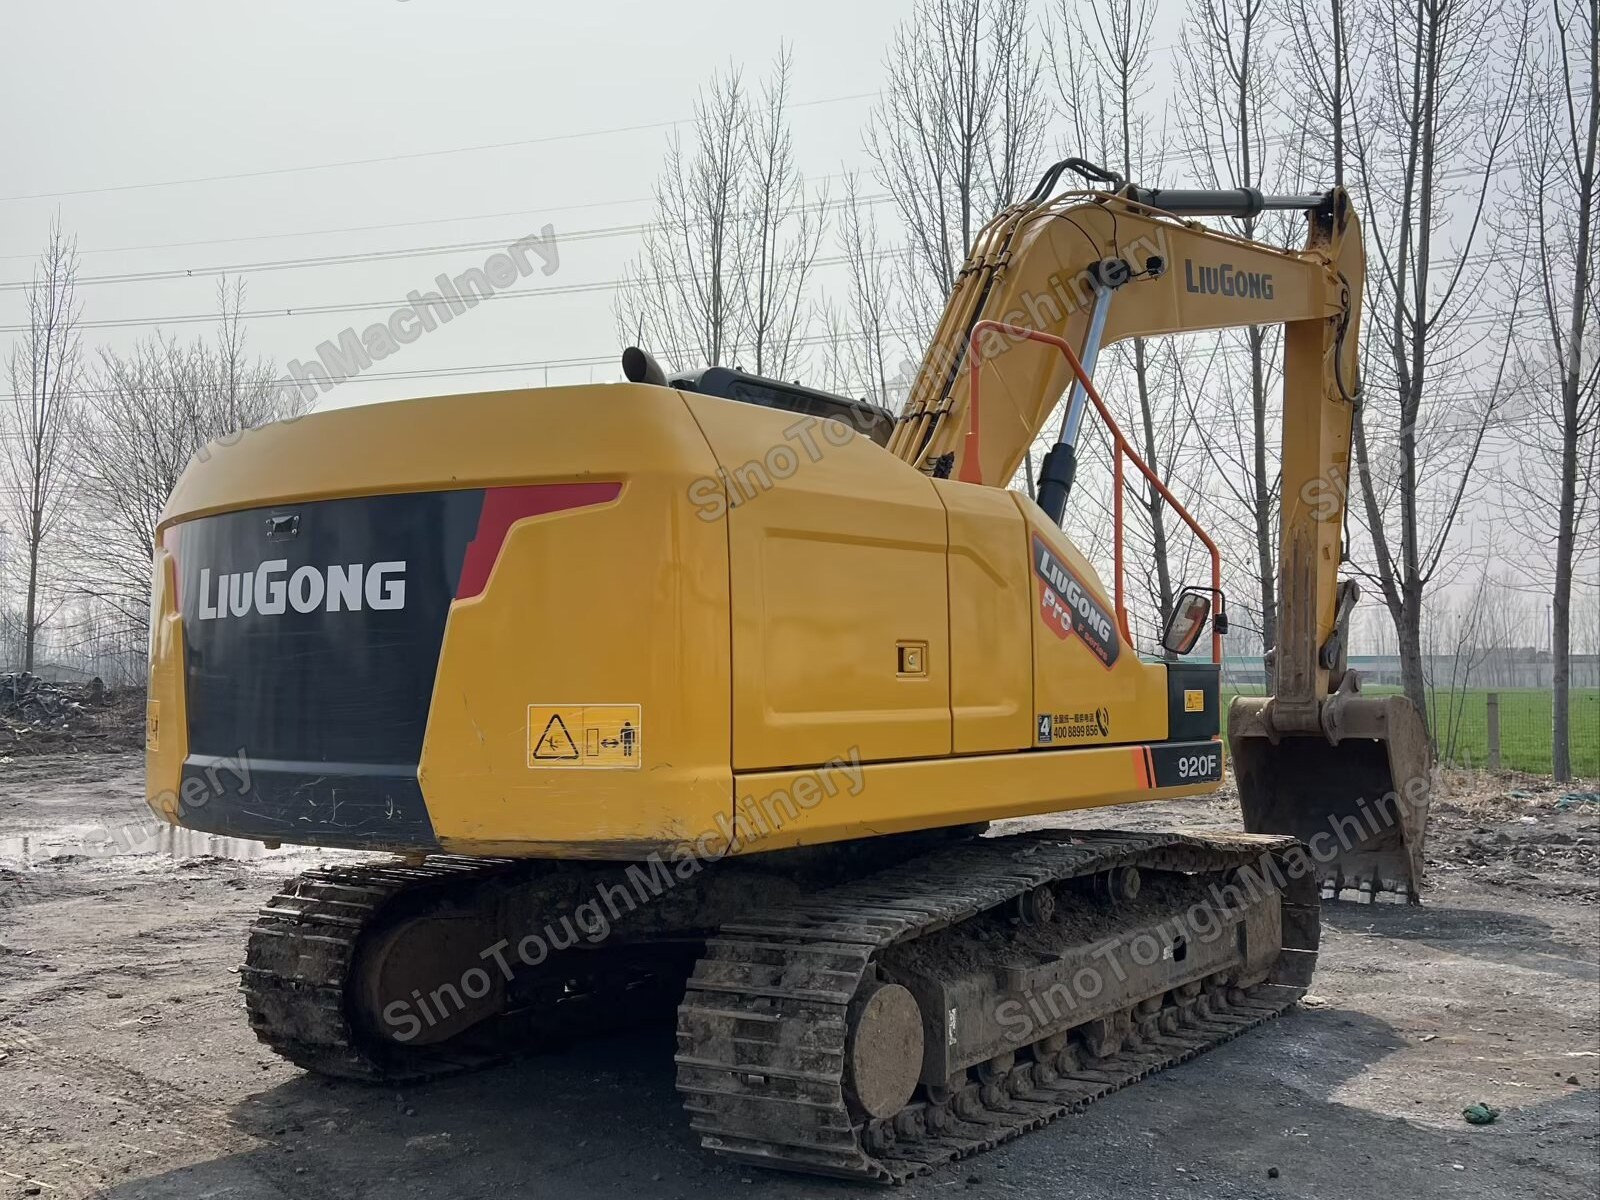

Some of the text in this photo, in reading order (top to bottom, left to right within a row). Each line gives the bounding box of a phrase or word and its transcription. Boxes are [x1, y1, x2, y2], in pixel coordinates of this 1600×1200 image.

[1053, 724, 1099, 739] 400 8899 856
[1178, 755, 1217, 778] 920F
